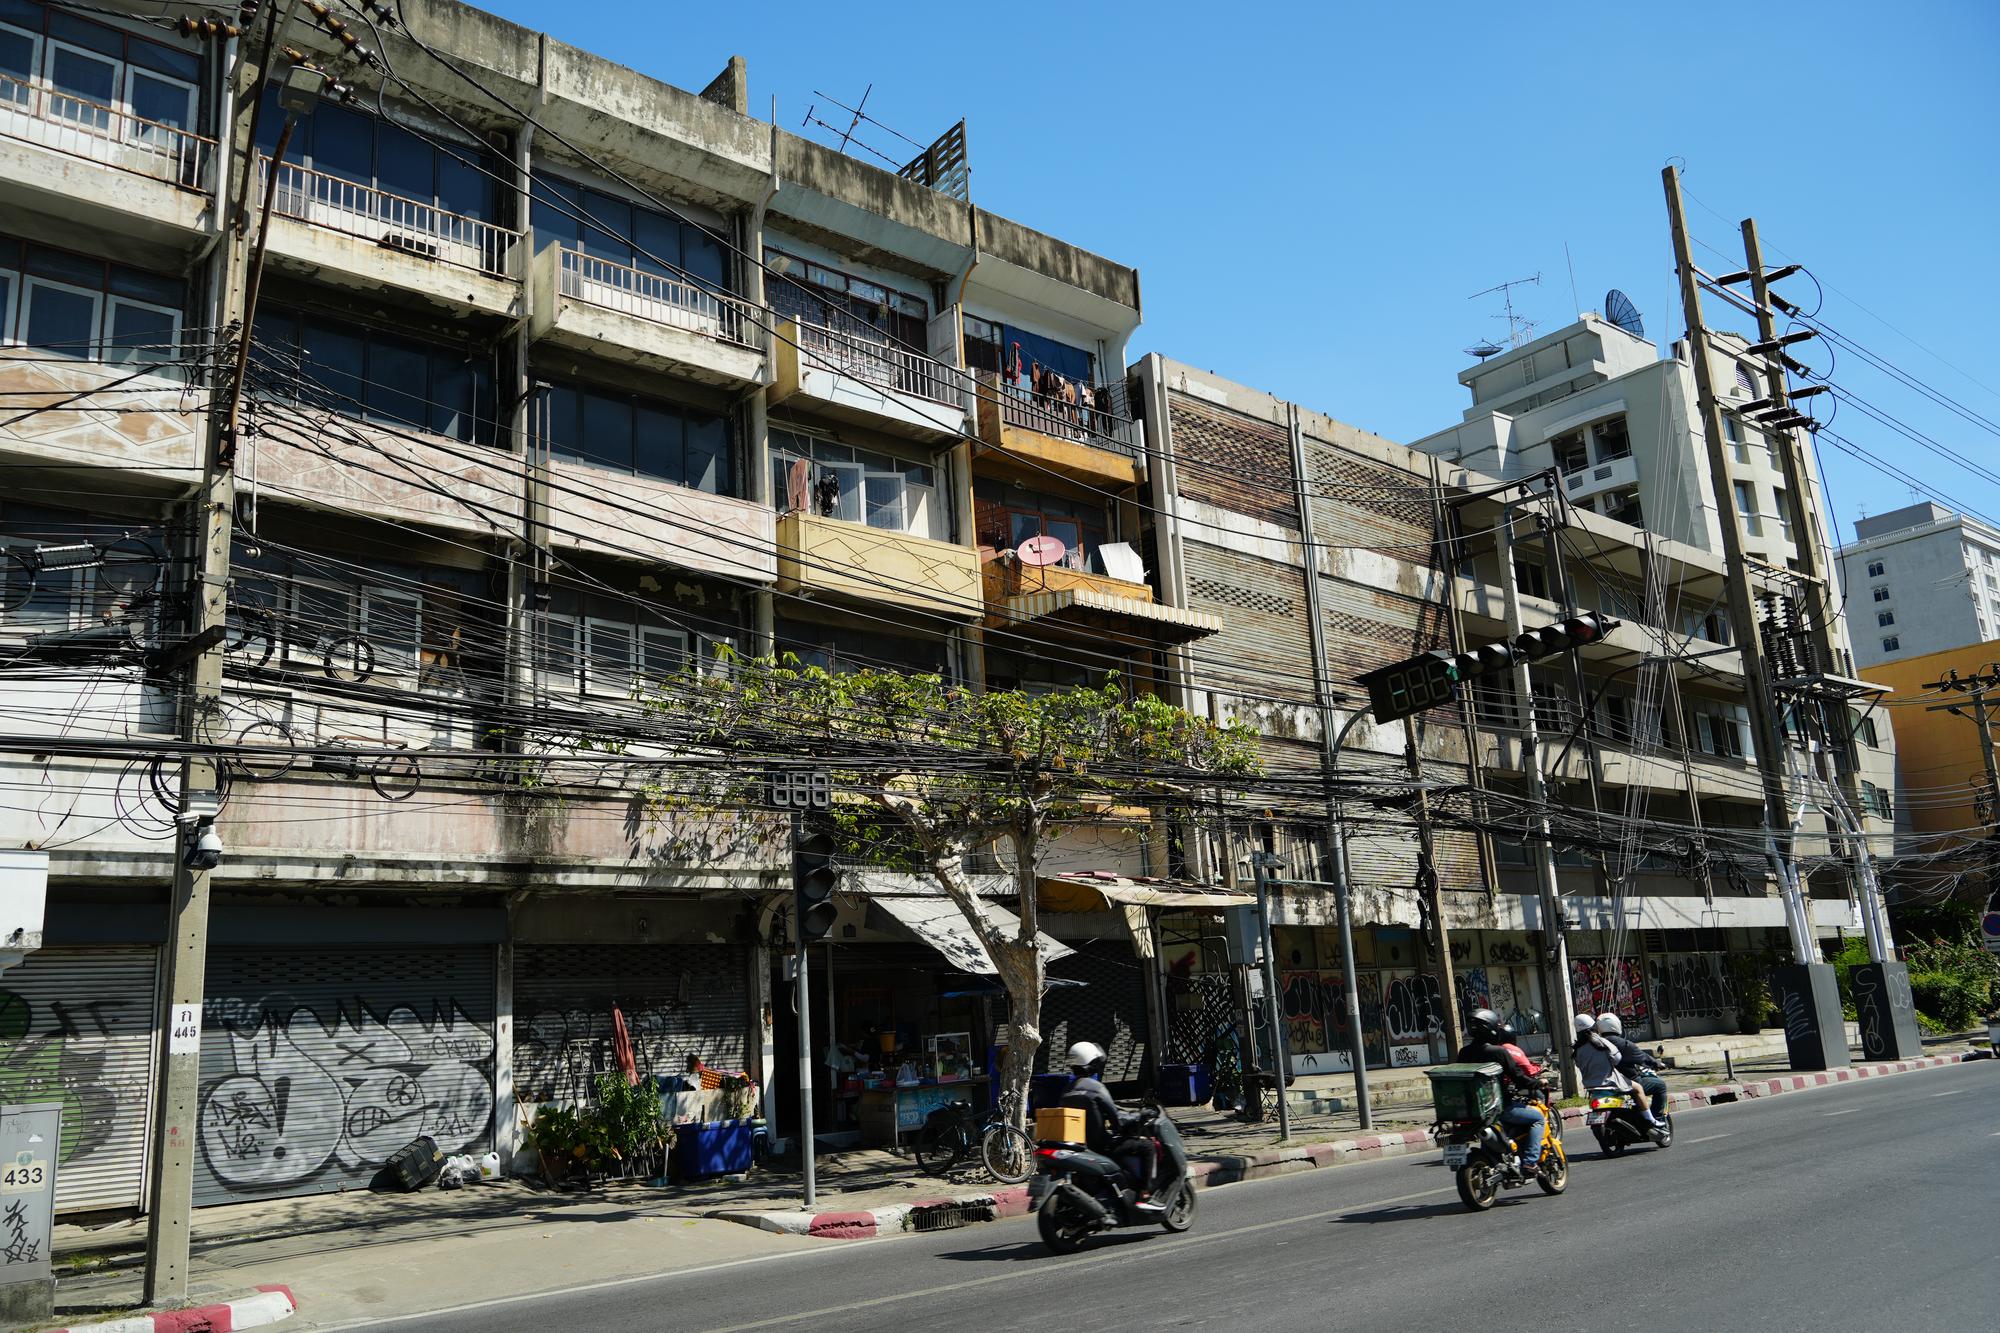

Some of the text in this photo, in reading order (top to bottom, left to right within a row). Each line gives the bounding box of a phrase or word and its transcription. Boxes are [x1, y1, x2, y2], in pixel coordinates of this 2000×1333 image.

[181, 1010, 192, 1022] ก
[174, 1025, 196, 1039] 445
[4, 1167, 43, 1186] 433
